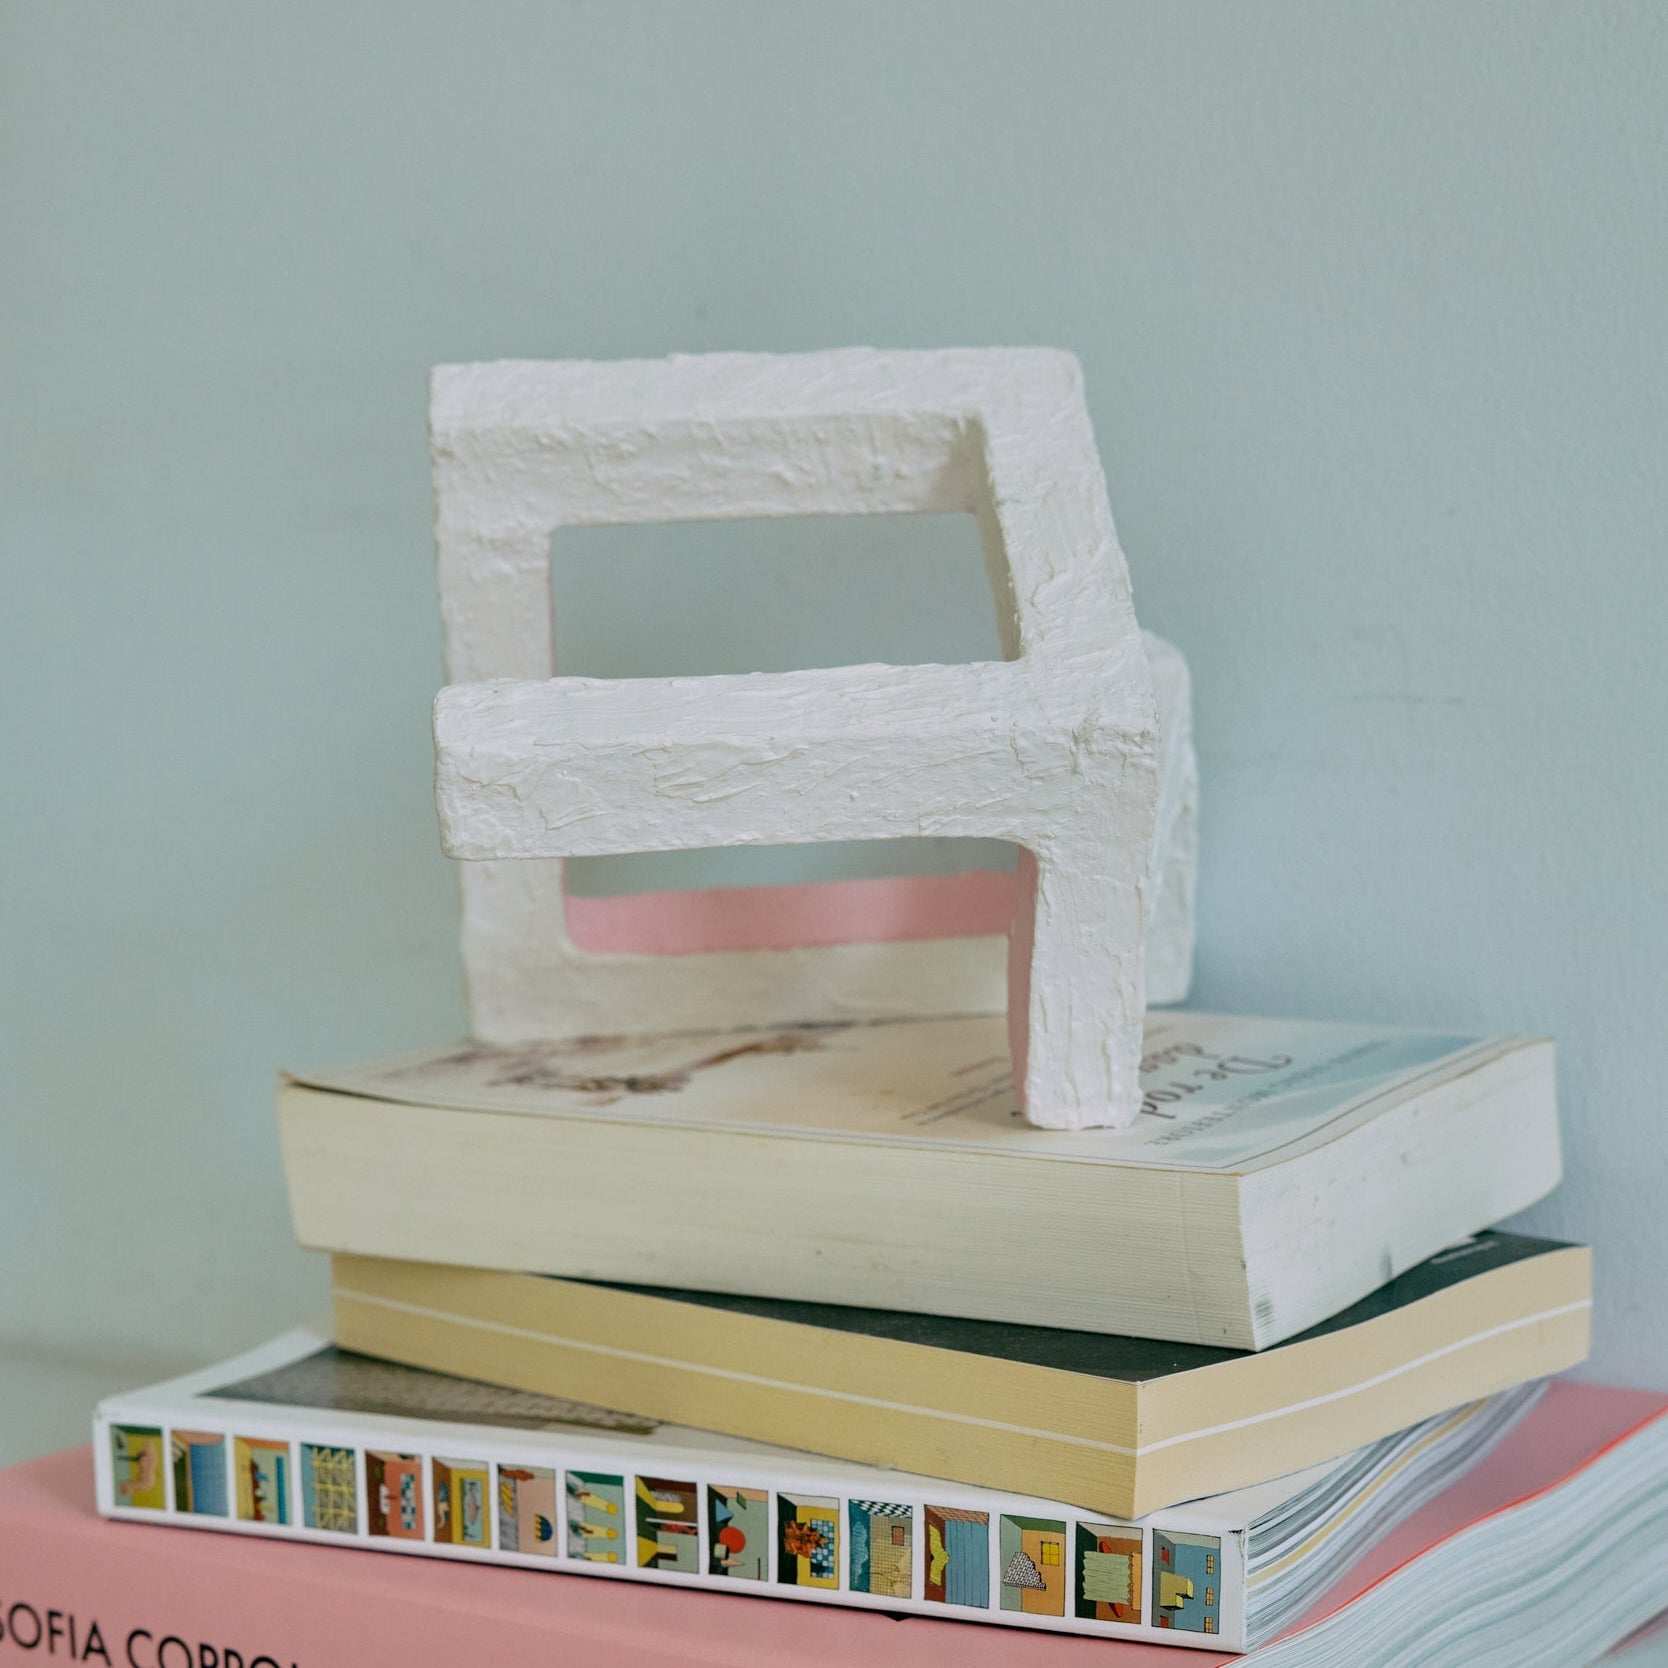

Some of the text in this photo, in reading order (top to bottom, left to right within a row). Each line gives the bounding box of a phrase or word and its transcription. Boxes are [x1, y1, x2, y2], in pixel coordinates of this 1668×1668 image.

[1193, 1054, 1293, 1081] De
[1139, 1082, 1203, 1120] rod
[0, 1600, 112, 1668] OFIA
